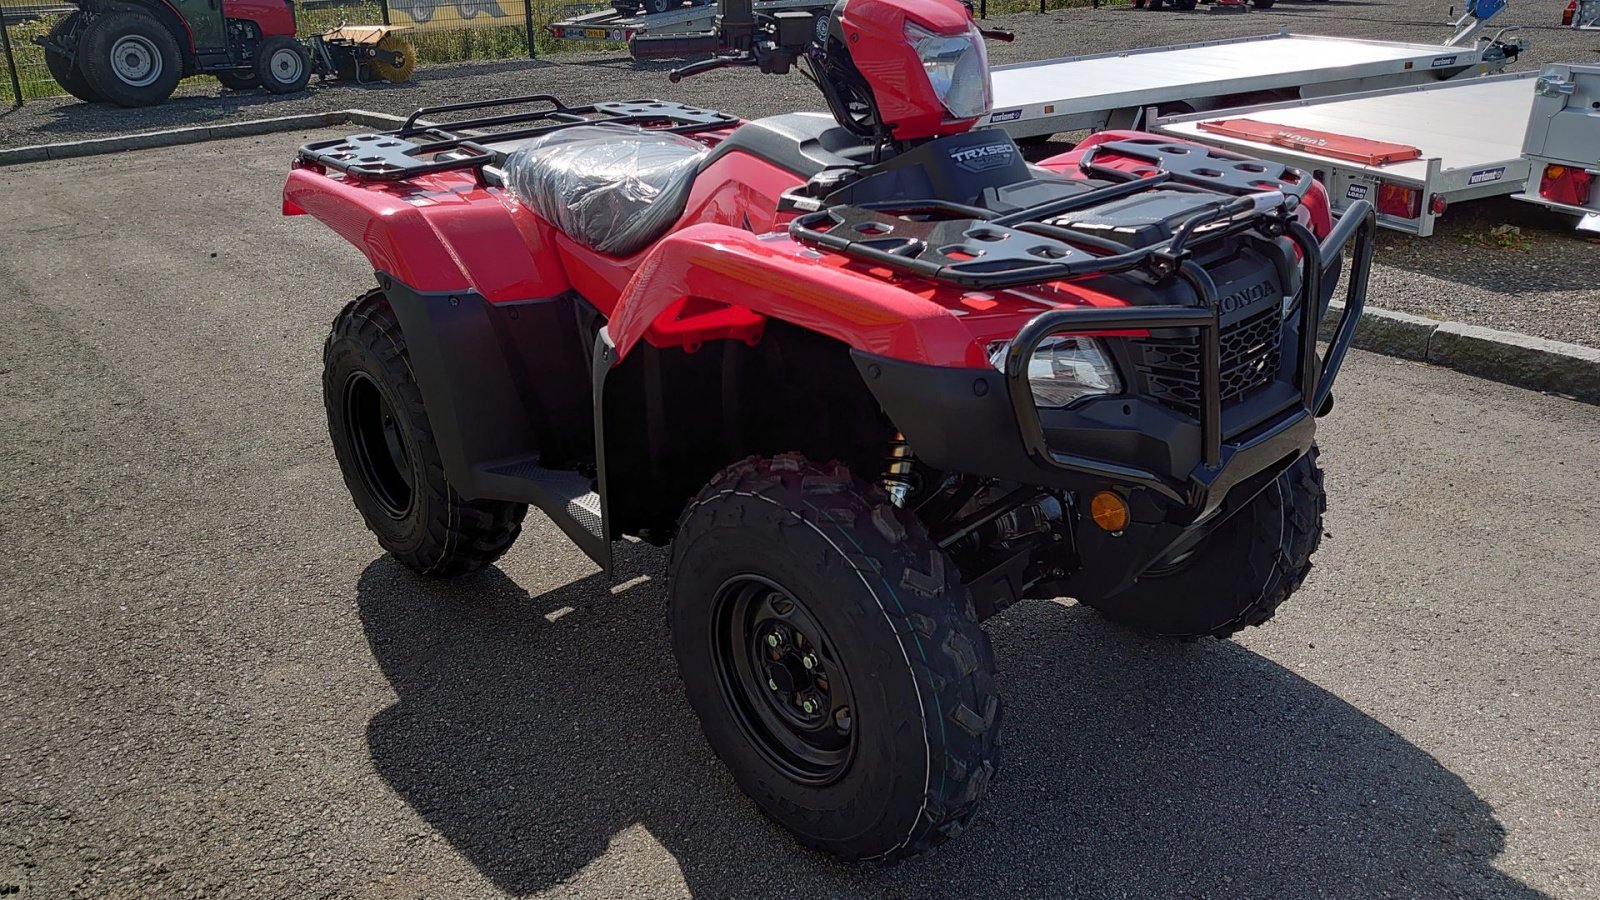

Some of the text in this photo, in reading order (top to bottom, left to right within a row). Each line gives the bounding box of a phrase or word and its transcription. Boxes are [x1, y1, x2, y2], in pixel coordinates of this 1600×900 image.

[992, 111, 1015, 122] variant
[950, 143, 1014, 162] TRX520
[1471, 169, 1497, 184] variant
[1350, 185, 1367, 193] MAXI
